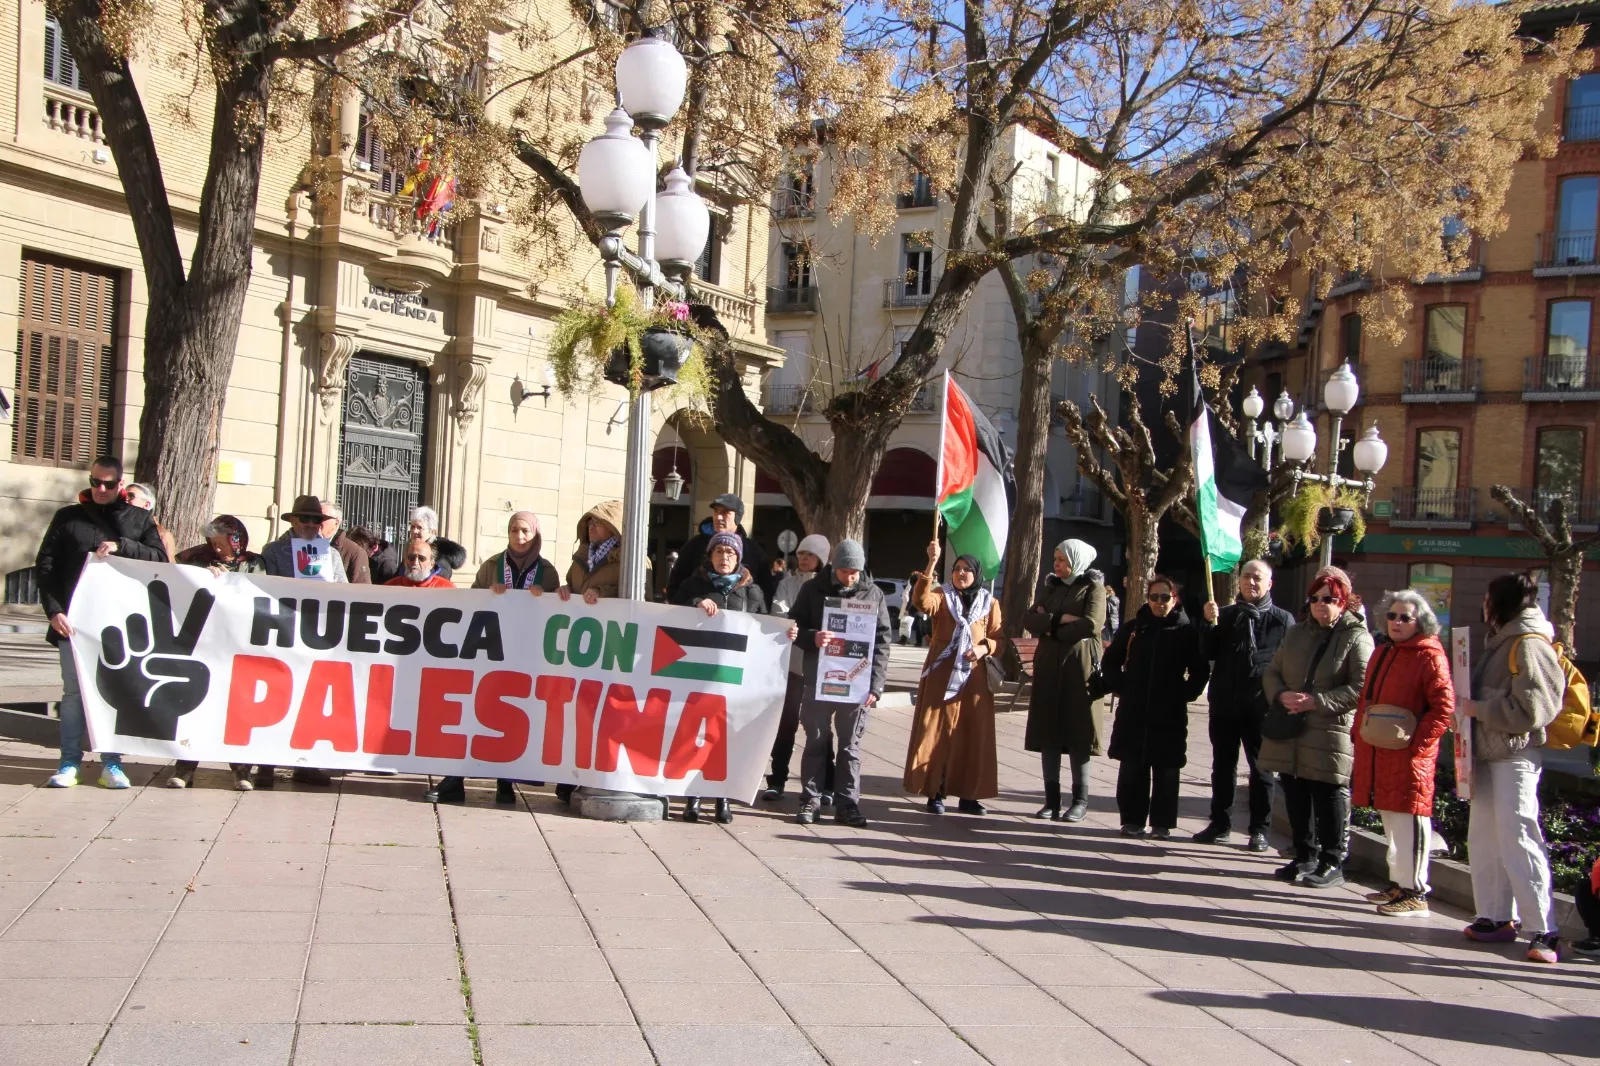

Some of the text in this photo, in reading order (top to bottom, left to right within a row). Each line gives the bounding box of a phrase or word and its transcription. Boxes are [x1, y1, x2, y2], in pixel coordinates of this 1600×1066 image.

[847, 602, 872, 610] BOICOT
[250, 596, 639, 673] HUESCA CON
[848, 660, 869, 679] BOICOT
[223, 654, 728, 782] PALESTINA
